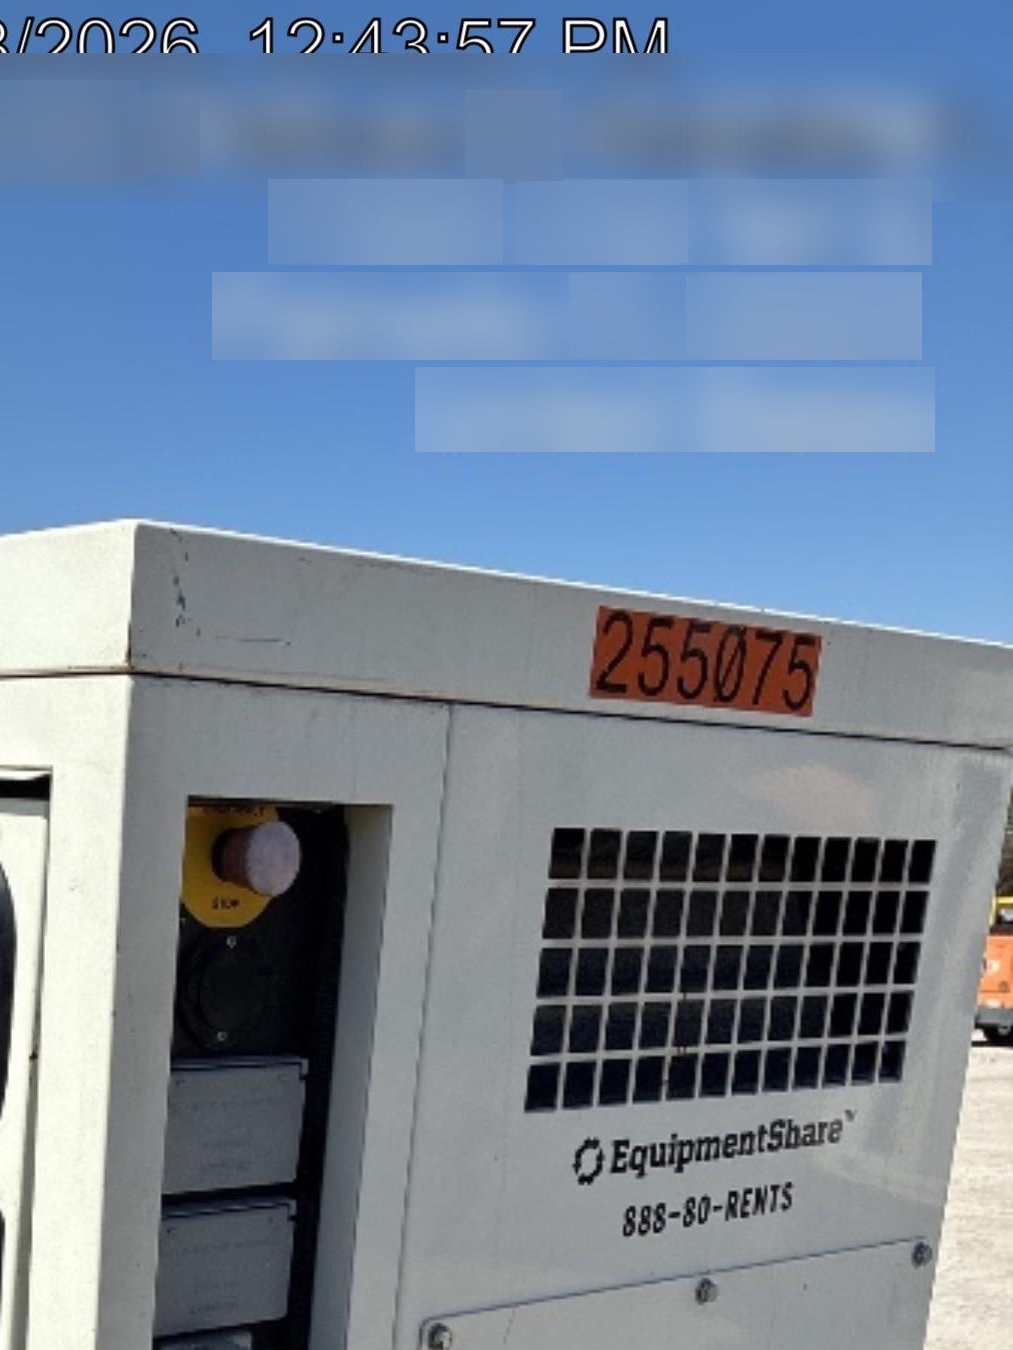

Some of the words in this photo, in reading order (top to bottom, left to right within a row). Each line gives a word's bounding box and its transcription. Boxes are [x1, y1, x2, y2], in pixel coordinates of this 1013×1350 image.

[595, 610, 816, 711] 255075
[609, 1118, 844, 1179] EquipmentShare
[622, 1180, 795, 1238] 888-80-RENTS
